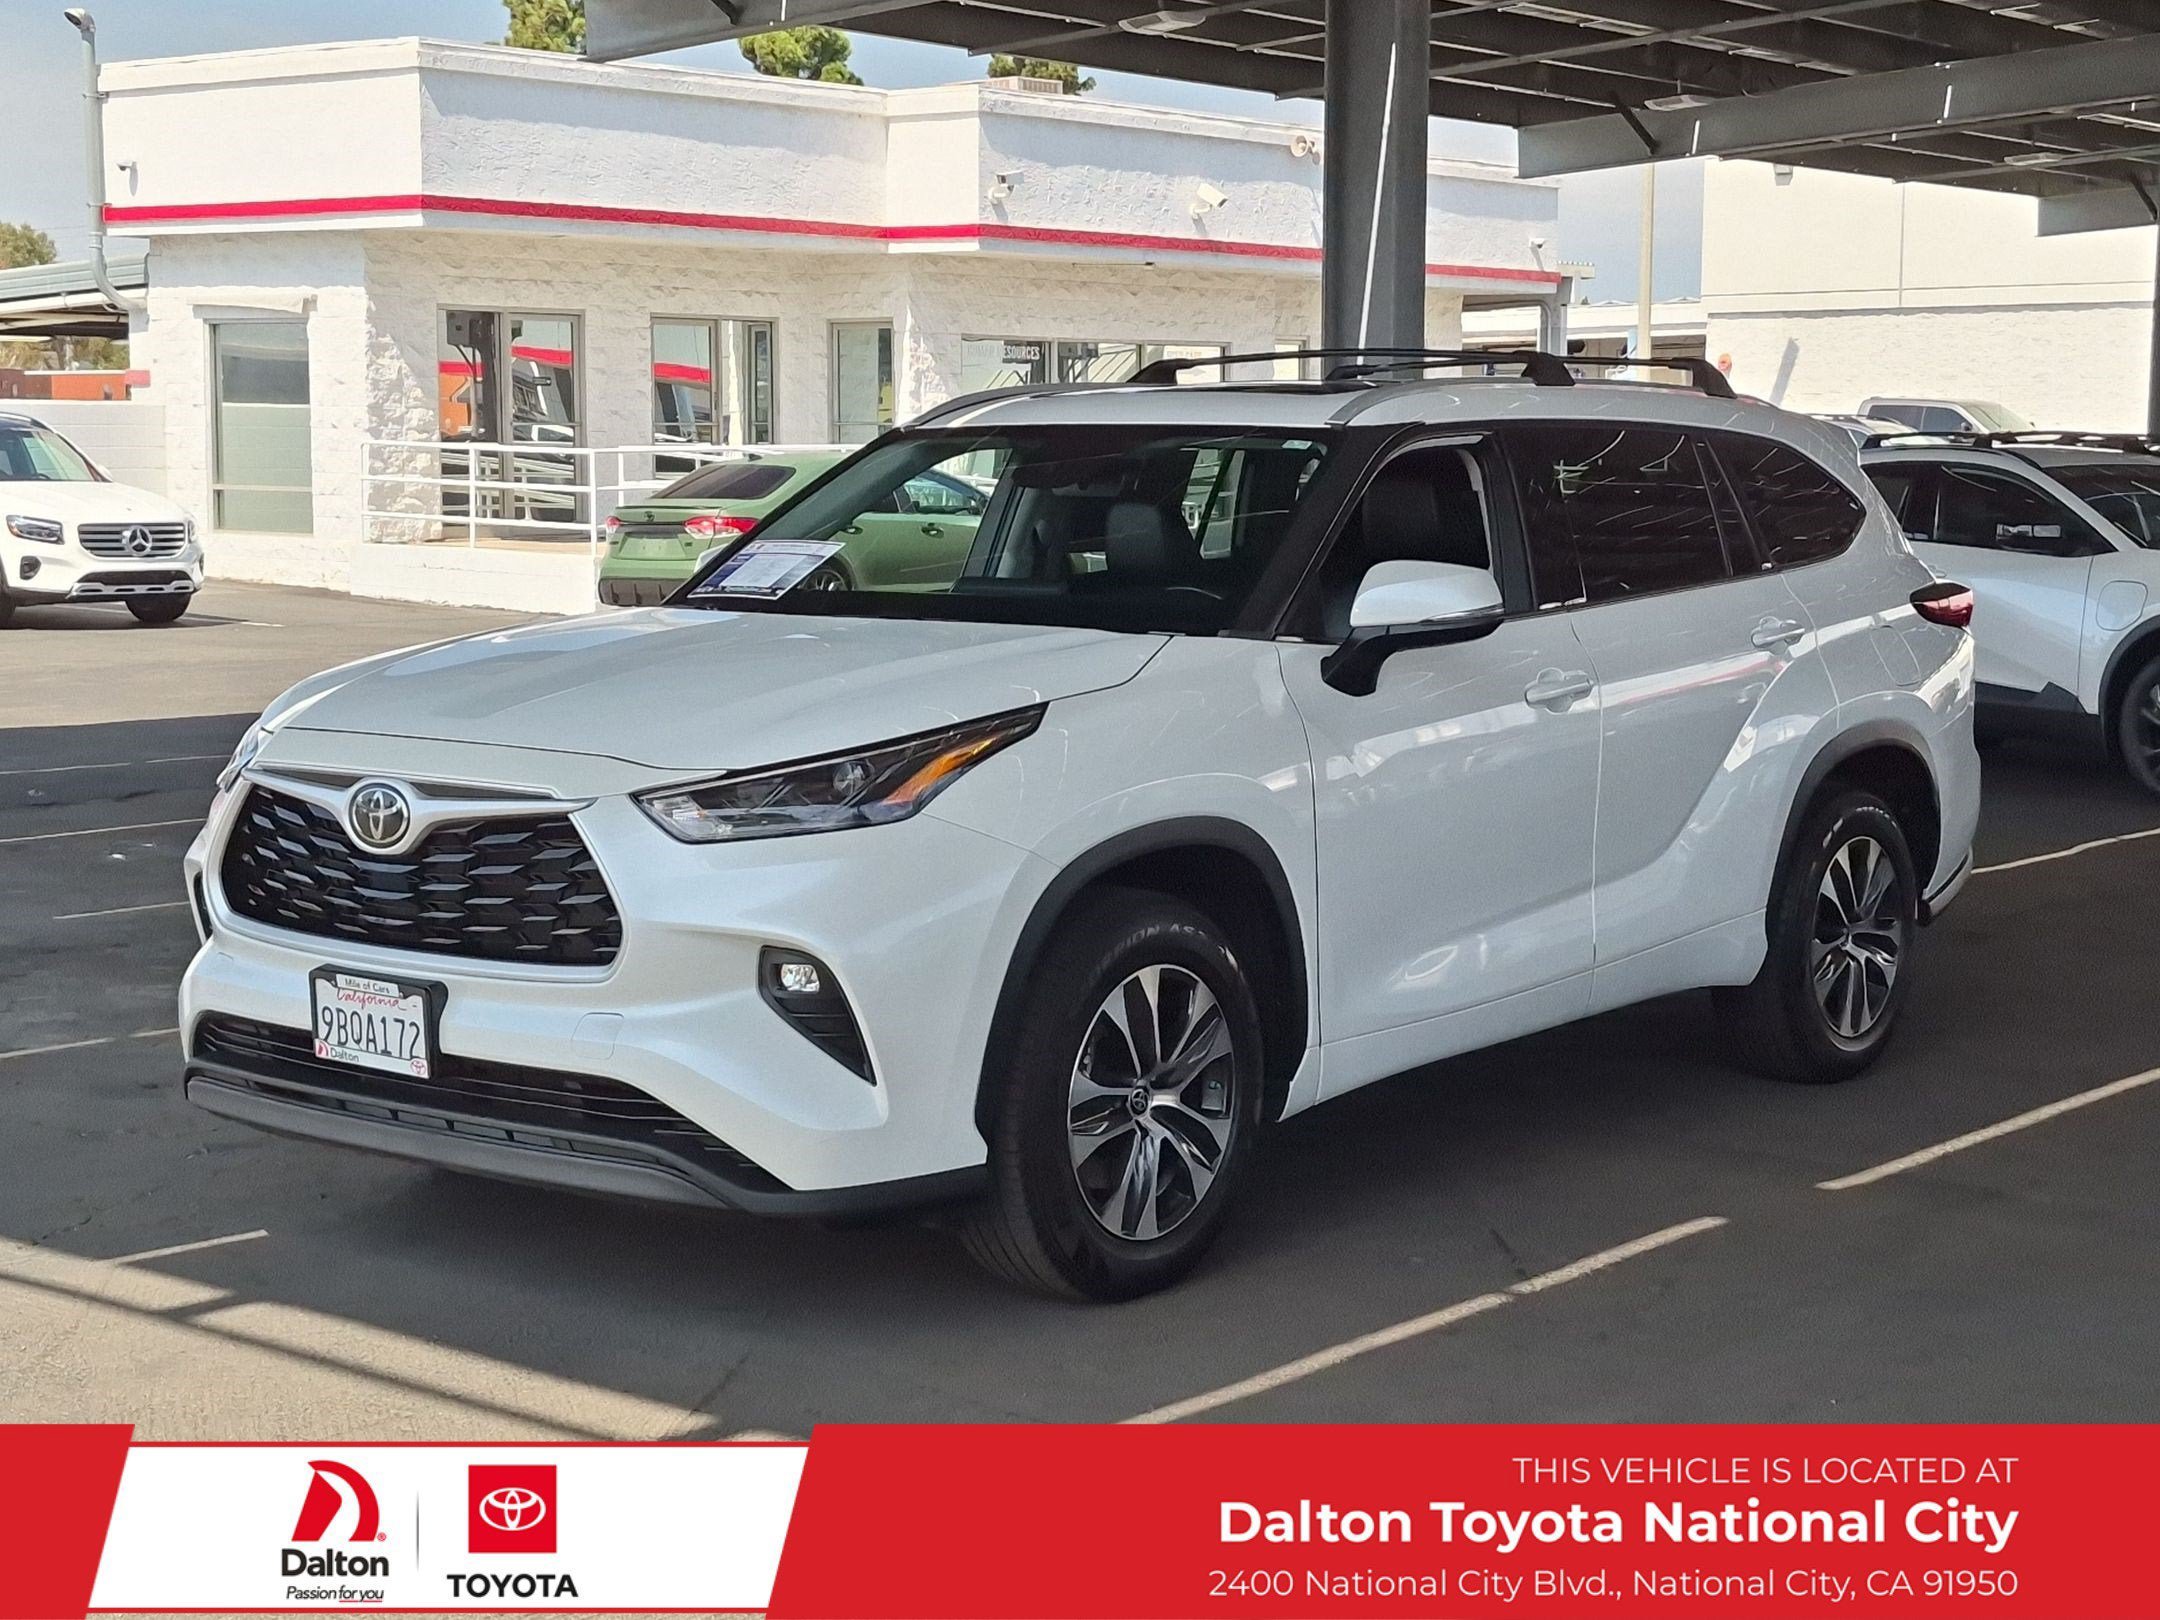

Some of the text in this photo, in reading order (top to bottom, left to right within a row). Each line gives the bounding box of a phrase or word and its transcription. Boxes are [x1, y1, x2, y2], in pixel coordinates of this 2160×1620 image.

[344, 978, 390, 994] Mile of Cars
[337, 989, 403, 1010] California
[322, 1006, 420, 1060] 9BQA172
[330, 1047, 360, 1063] Dalton
